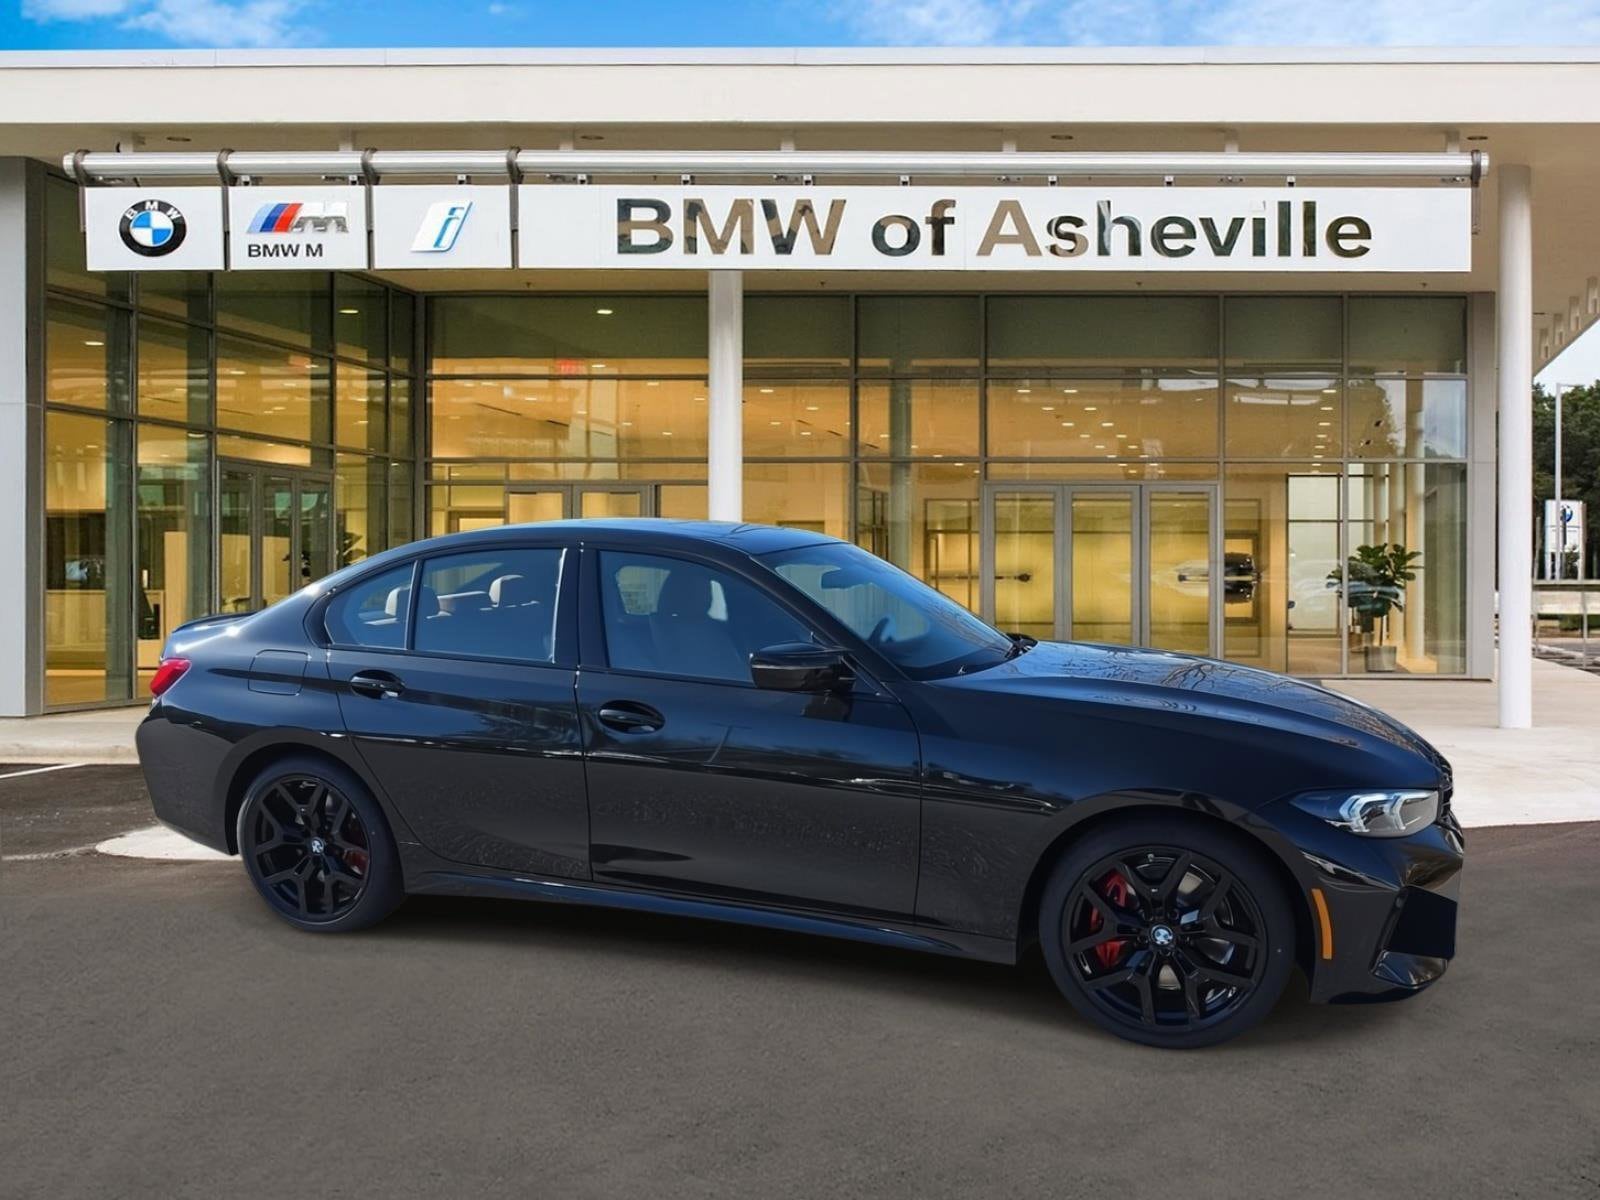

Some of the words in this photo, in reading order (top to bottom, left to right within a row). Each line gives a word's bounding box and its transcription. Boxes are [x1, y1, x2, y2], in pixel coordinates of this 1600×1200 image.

[125, 201, 181, 220] BMW
[616, 198, 847, 255] BMW
[871, 199, 956, 257] of
[976, 200, 1372, 258] Asheville
[248, 243, 300, 258] BMW
[306, 243, 323, 258] M
